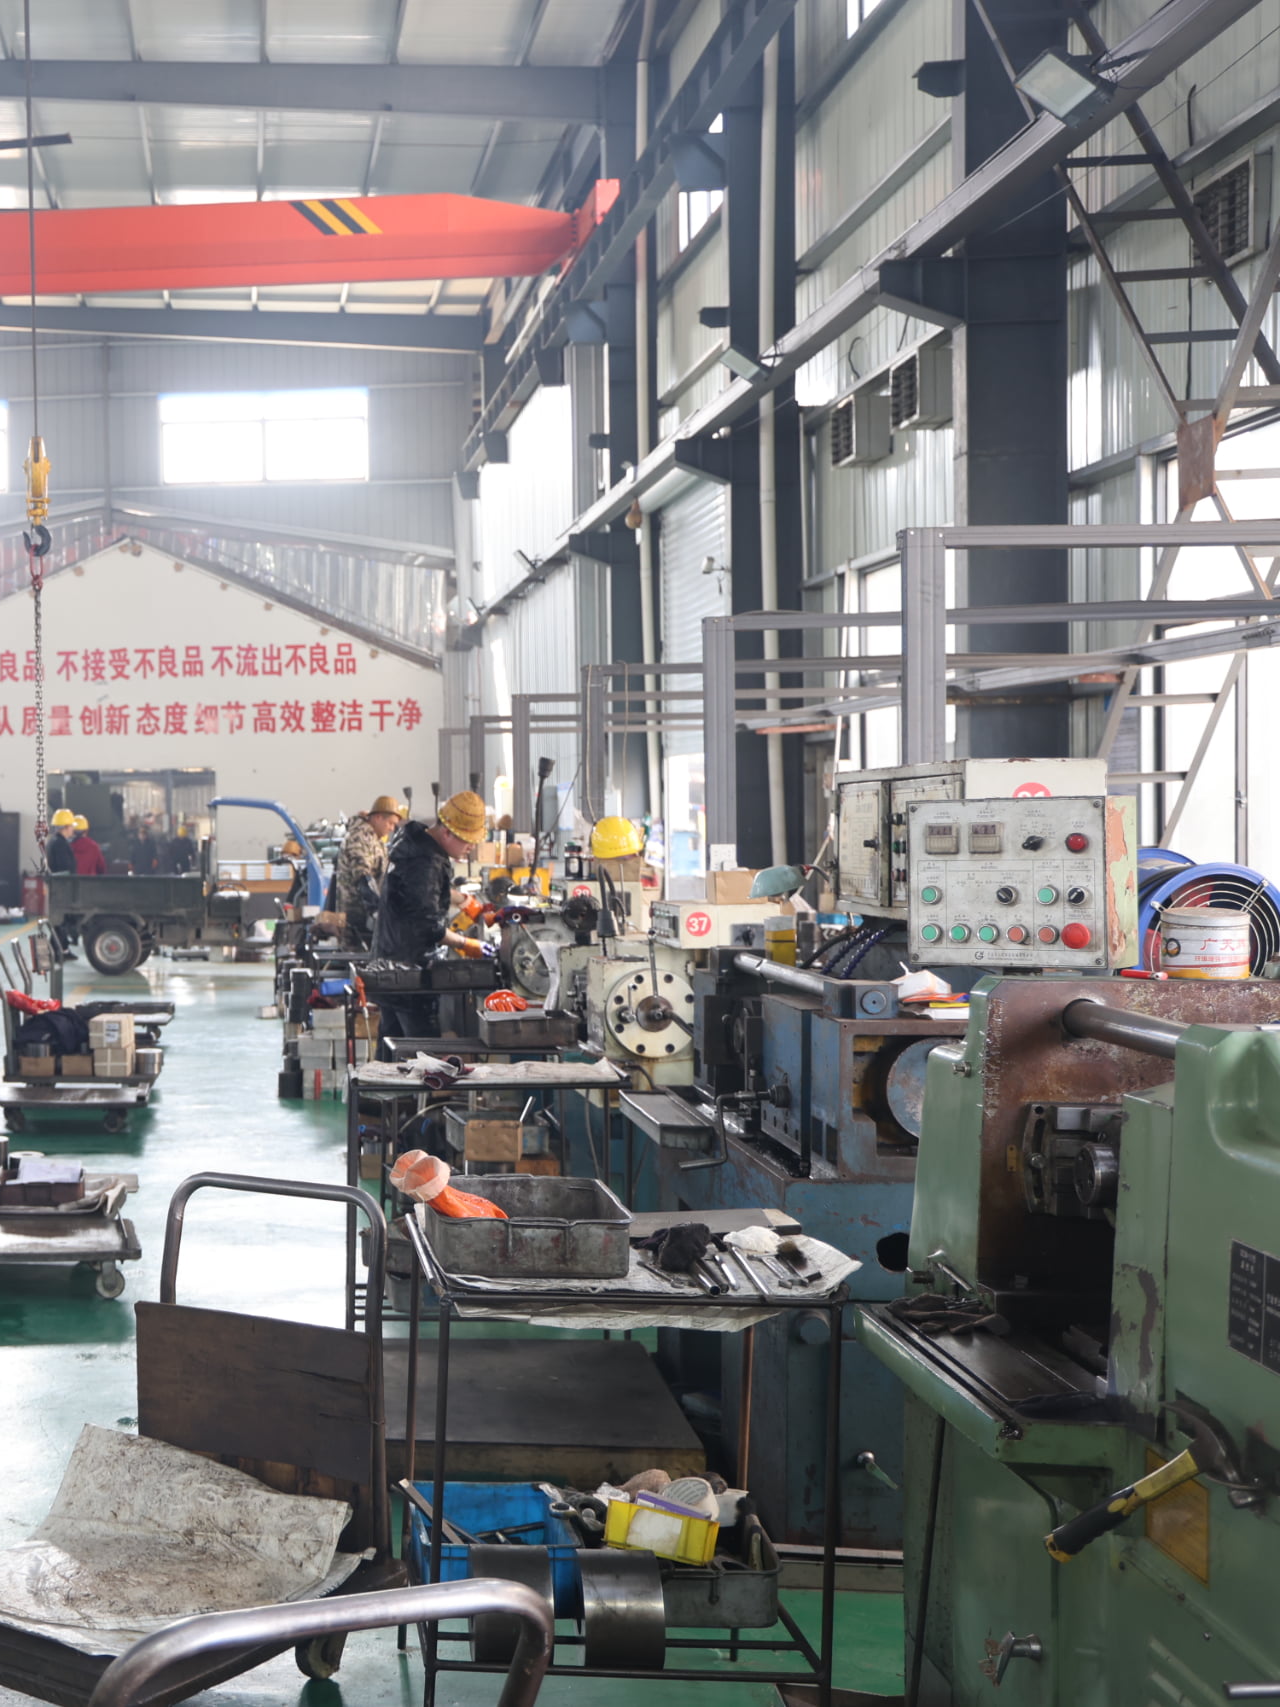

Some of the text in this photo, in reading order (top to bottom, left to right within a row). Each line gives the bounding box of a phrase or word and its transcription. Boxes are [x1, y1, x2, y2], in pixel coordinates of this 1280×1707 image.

[55, 645, 205, 682] 不接受不良品
[210, 642, 359, 678] 不流出不良品
[78, 703, 132, 737] 创新
[136, 702, 189, 736] 态度
[252, 699, 307, 734] 高效
[310, 699, 365, 733] 整洁
[369, 697, 424, 732] 干净
[689, 917, 708, 932] 37
